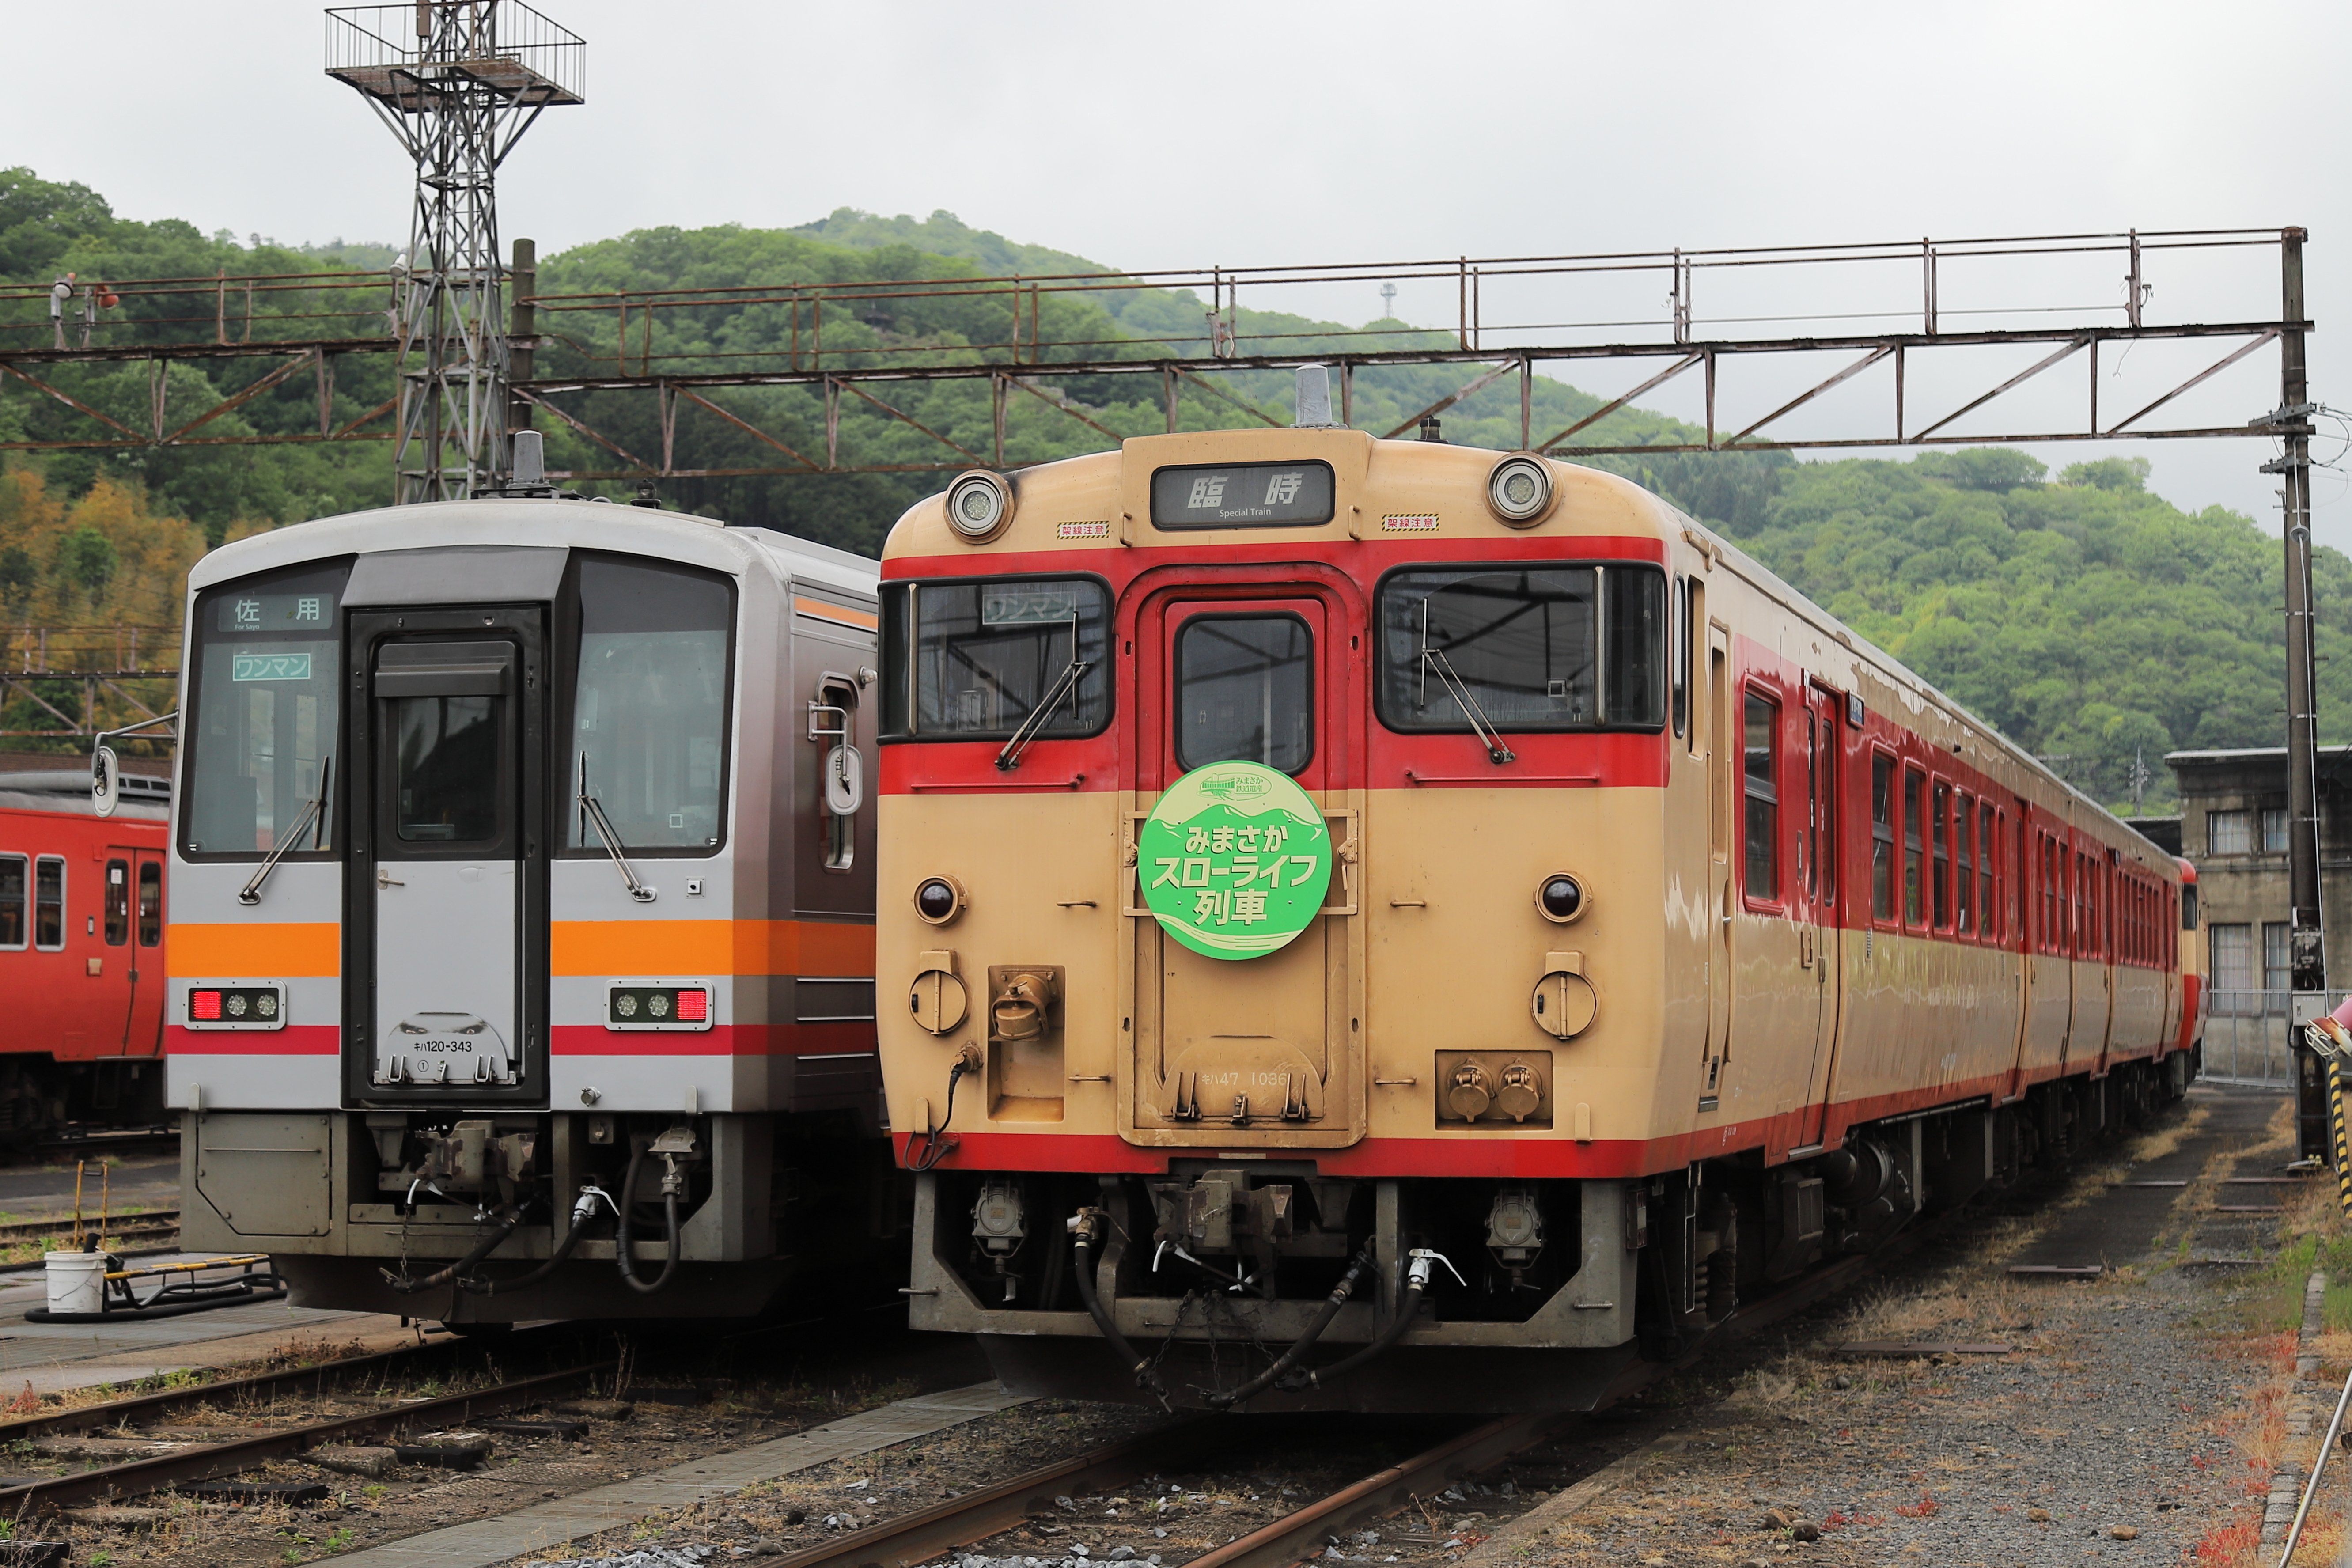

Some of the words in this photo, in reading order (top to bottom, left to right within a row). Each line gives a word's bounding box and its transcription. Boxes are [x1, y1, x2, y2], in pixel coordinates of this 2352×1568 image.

[1187, 472, 1304, 508] 臨時
[1219, 508, 1248, 519] Special
[1387, 518, 1433, 528] 架線注意
[1062, 525, 1103, 535] 架線注意
[235, 598, 319, 622] 佐用
[987, 597, 1072, 620] ワンマン
[236, 657, 307, 678] ワンマン
[1185, 825, 1288, 854] みまさか
[1151, 855, 1318, 890] スローライフ
[1193, 888, 1269, 926] 列車
[414, 1041, 472, 1052] キハ120-343
[1201, 1072, 1239, 1086] キハ47
[1251, 1072, 1287, 1086] 1036
